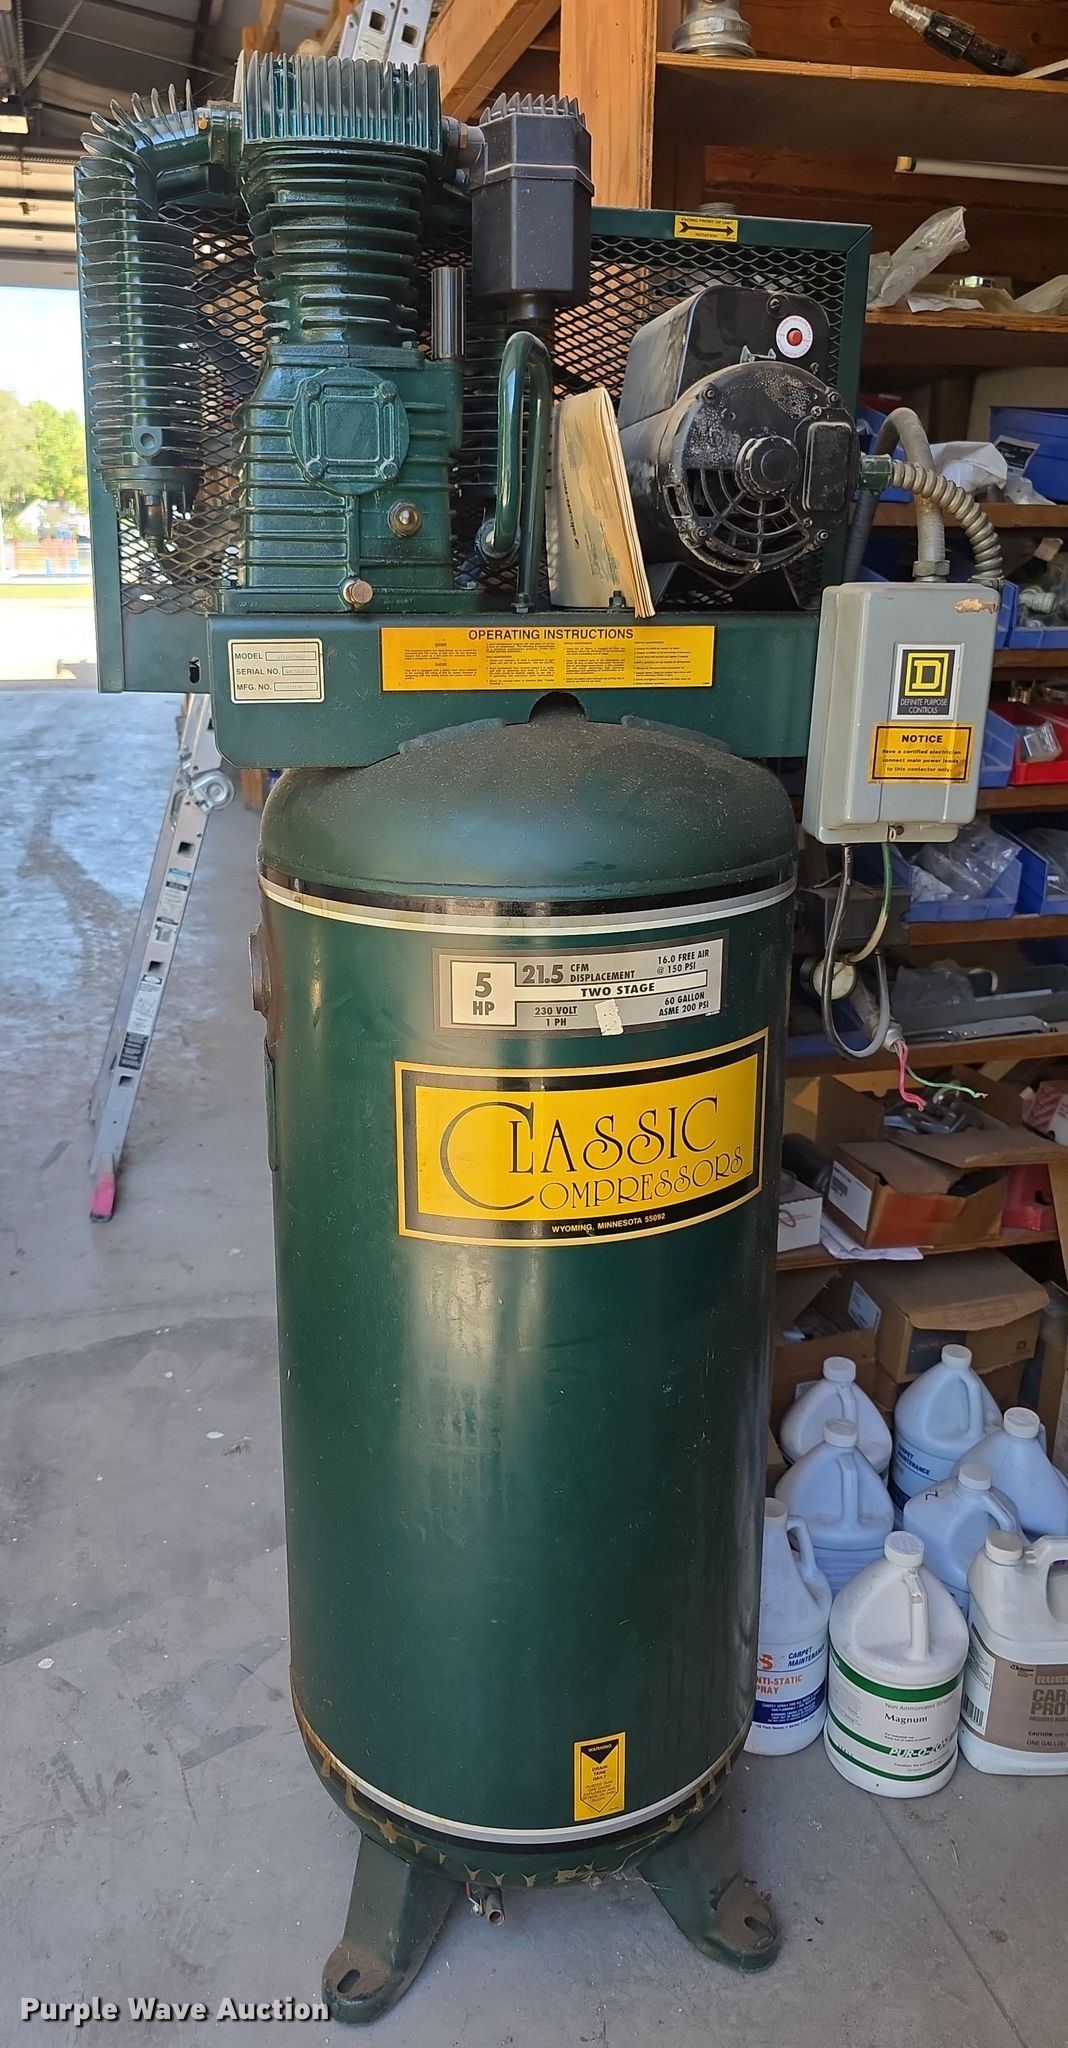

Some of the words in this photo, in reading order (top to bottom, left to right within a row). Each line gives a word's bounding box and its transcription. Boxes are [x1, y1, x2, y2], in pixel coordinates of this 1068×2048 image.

[468, 630, 540, 640] OPERATING
[544, 628, 634, 640] INSTRUCTIONS
[235, 652, 263, 660] MODEL
[900, 698, 923, 706] DEFINITE
[924, 698, 948, 706] PURPOSE
[908, 706, 938, 714] CONTROLS
[901, 735, 943, 743] NOTICE
[658, 955, 675, 965] 16.0
[678, 952, 695, 962] FREE
[697, 949, 709, 959] AIR
[522, 964, 564, 984] 21.5
[570, 964, 589, 972] CFM
[657, 967, 664, 975] @
[667, 964, 682, 974] 150
[685, 961, 696, 971] PSI
[570, 970, 635, 982] DISPLACEMENT
[475, 972, 492, 998] 5
[581, 987, 611, 997] TWO
[616, 983, 655, 994] STAGE
[664, 997, 675, 1006] 60
[678, 992, 705, 1003] GALLON
[472, 1001, 495, 1016] HP
[534, 1007, 553, 1015] 230
[556, 1006, 578, 1014] VOLT
[659, 1005, 679, 1016] ASME
[681, 1003, 696, 1012] 200
[698, 1000, 709, 1010] PSI
[554, 1018, 567, 1026] PH
[440, 1094, 719, 1210] CLASSIC
[551, 1224, 595, 1233] WYOMING,
[597, 1217, 642, 1229] MINNESOTA
[644, 1213, 666, 1223] 55092
[788, 1646, 812, 1660] CARPET
[756, 1675, 803, 1686] NTI-STATIC
[756, 1685, 779, 1694] PRAY
[1032, 1689, 1068, 1702] CAR
[884, 1702, 898, 1710] Non
[884, 1713, 928, 1725] Magnum
[588, 1743, 612, 1752] WARNING
